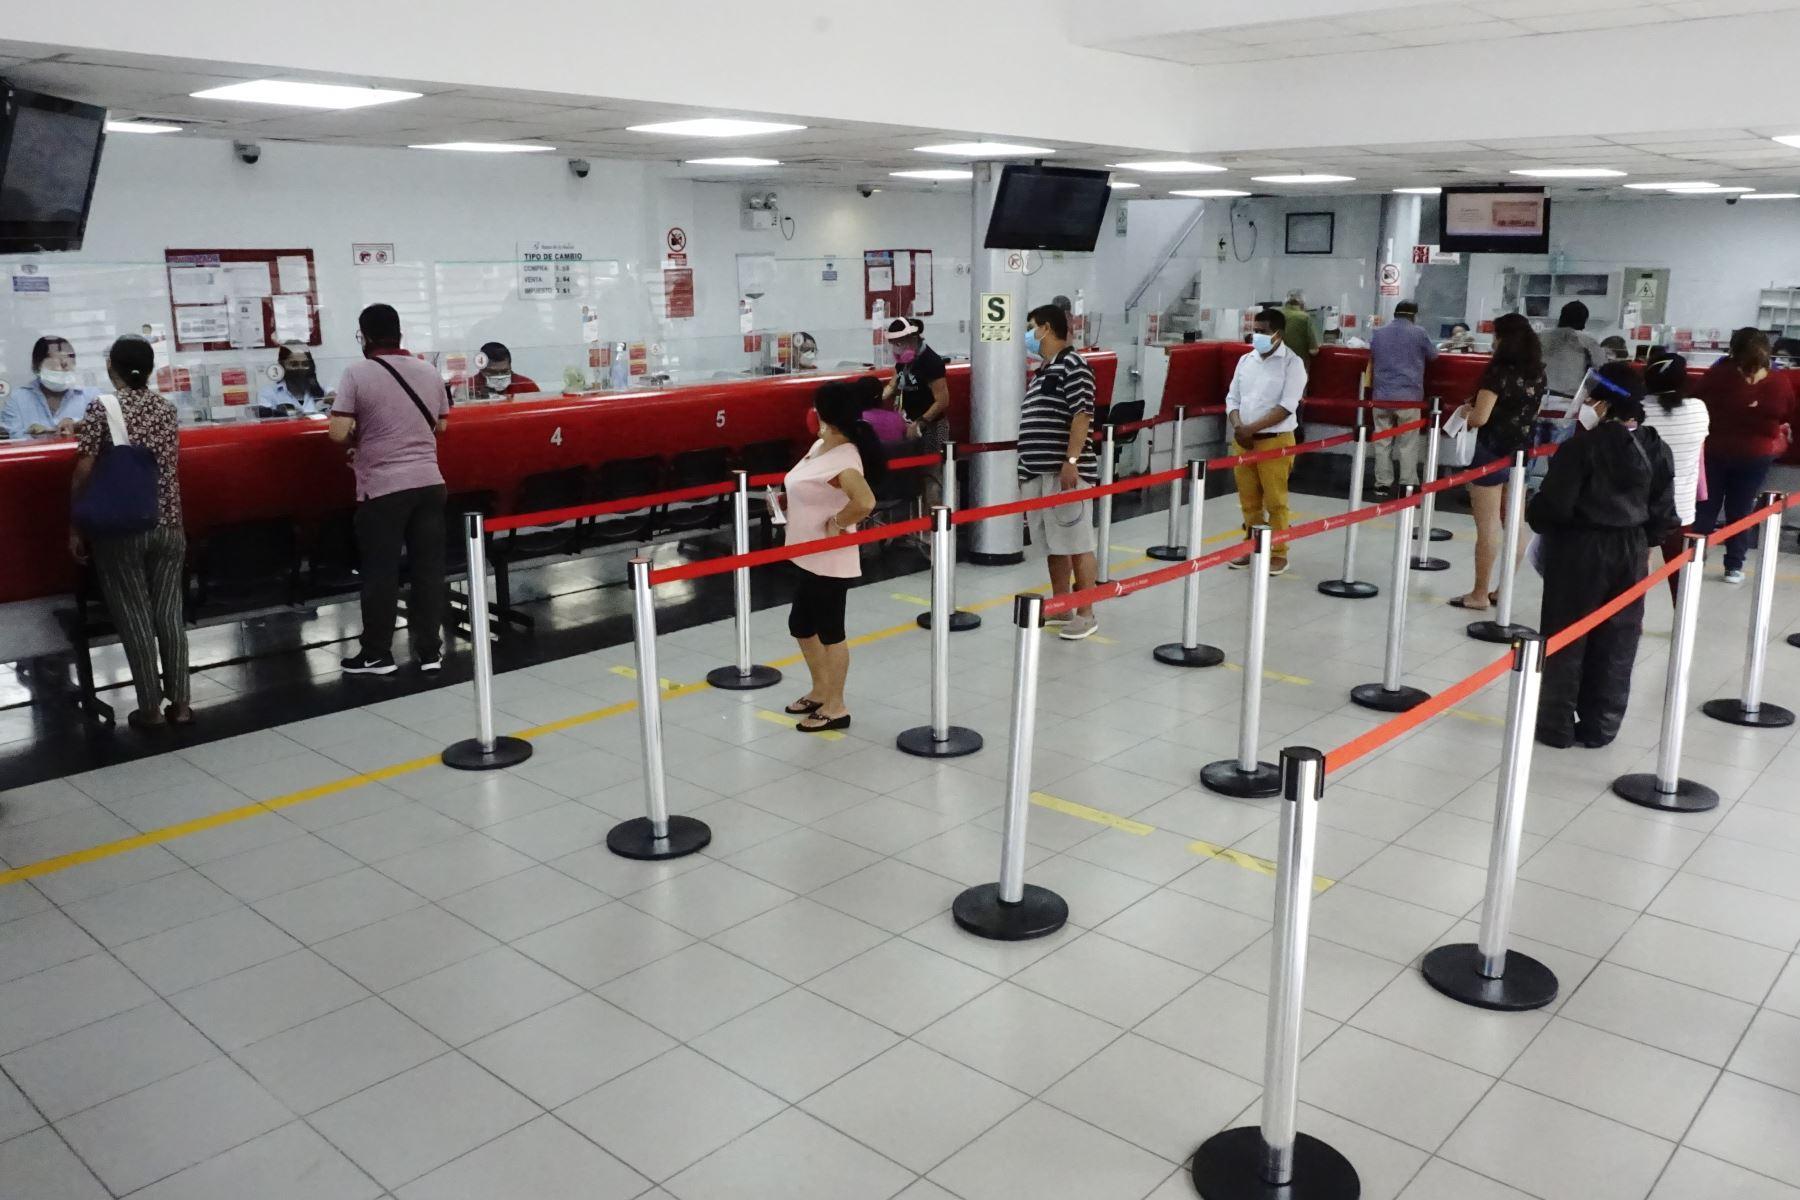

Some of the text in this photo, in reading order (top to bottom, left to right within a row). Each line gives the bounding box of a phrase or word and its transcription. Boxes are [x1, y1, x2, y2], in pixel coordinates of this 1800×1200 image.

[524, 253, 583, 261] TIPO DE CAMBIO
[987, 296, 1006, 322] S
[271, 366, 279, 378] 3
[715, 410, 726, 428] 5
[550, 426, 563, 446] 4
